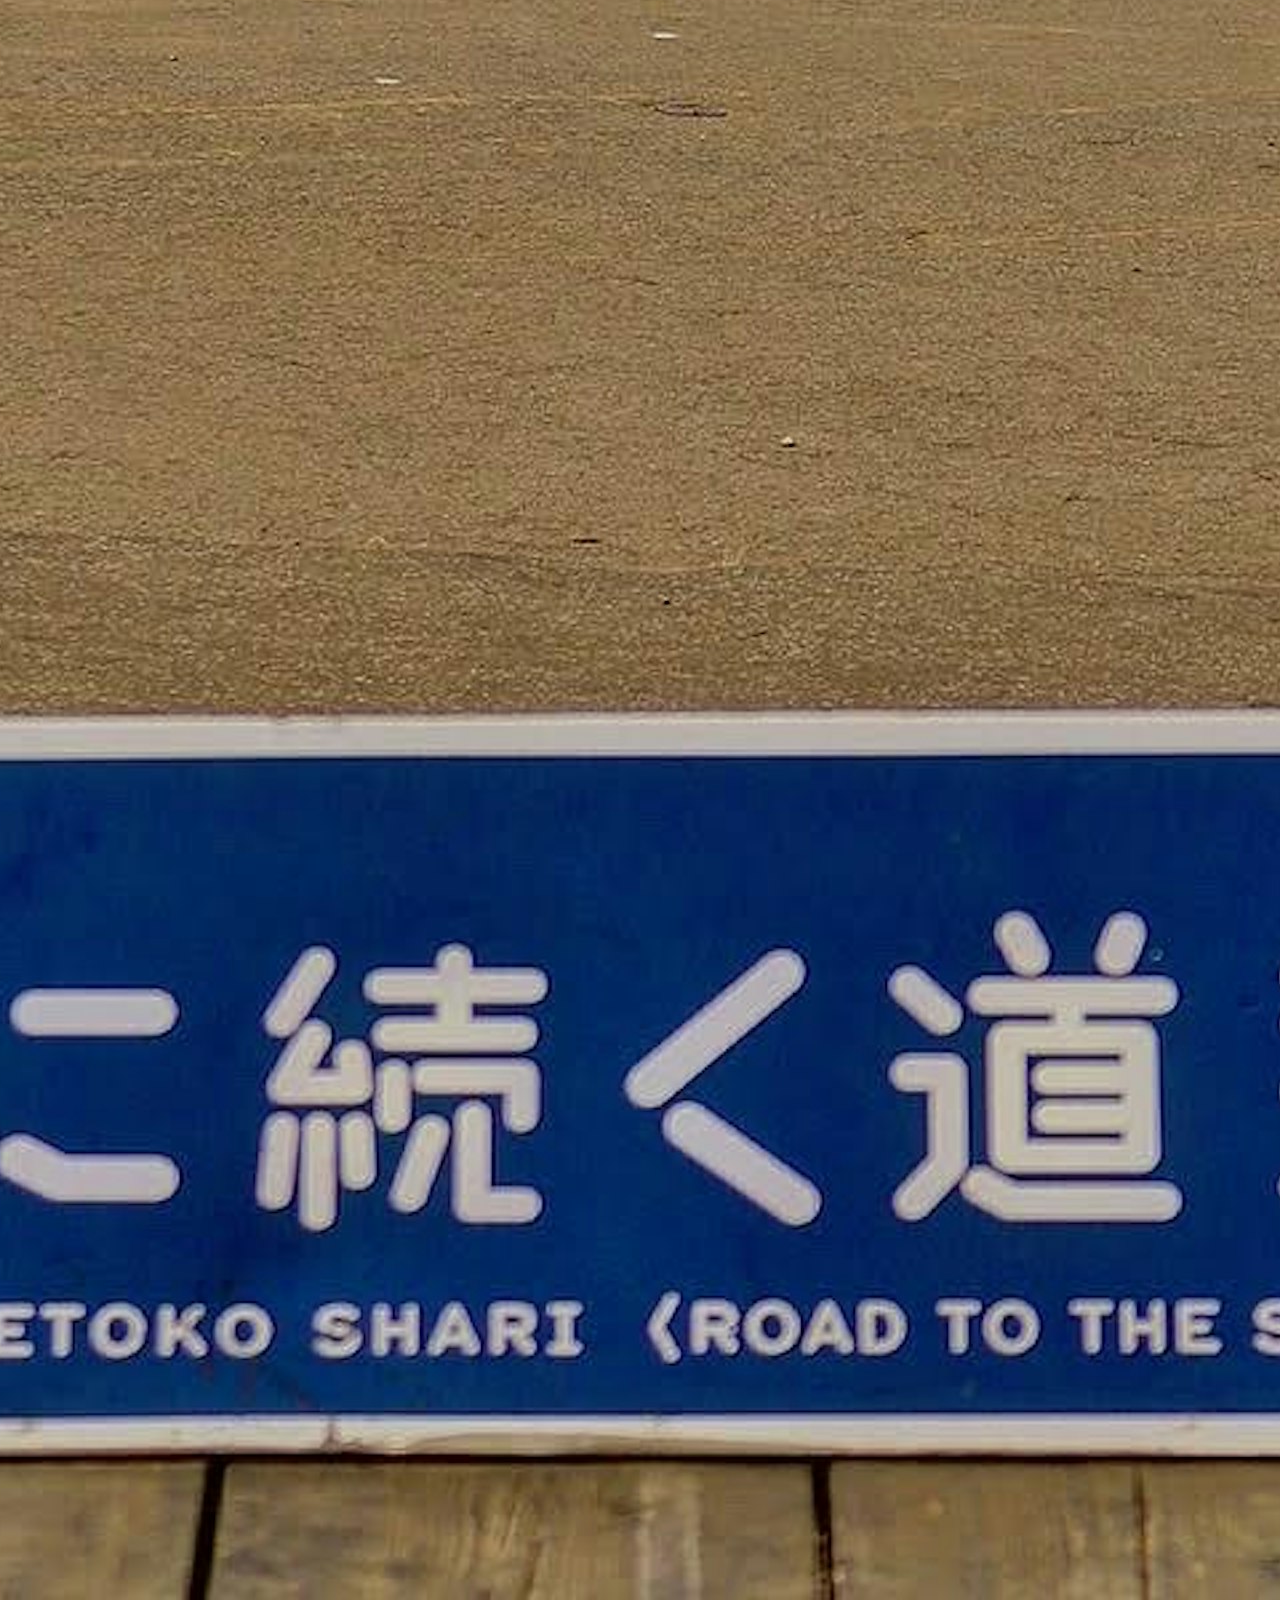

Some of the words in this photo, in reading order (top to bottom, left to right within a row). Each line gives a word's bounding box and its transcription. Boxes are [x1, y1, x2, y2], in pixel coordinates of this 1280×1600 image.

[312, 1300, 584, 1359] SHARI
[936, 1298, 1040, 1356] TO
[1068, 1298, 1223, 1356] THE
